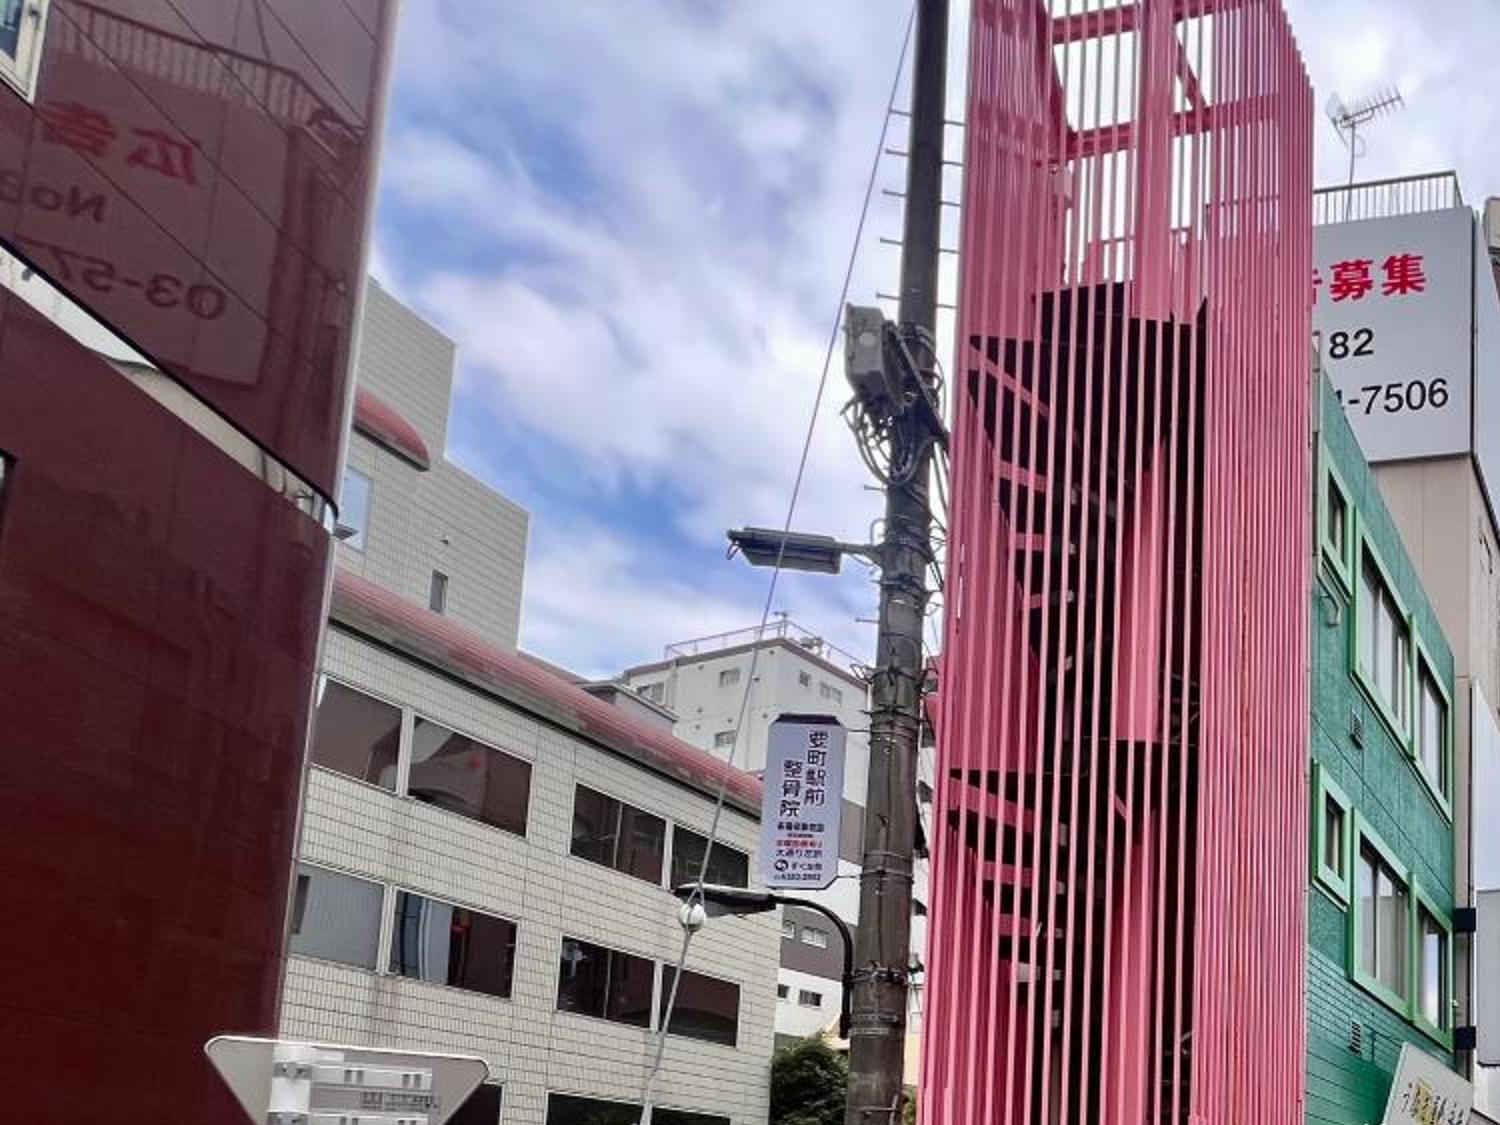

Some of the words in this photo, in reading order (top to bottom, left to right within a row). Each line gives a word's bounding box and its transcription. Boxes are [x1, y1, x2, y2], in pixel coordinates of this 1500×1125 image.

[1329, 328, 1374, 359] 82
[779, 760, 803, 817] 整骨院
[804, 731, 829, 806] 要町駅前
